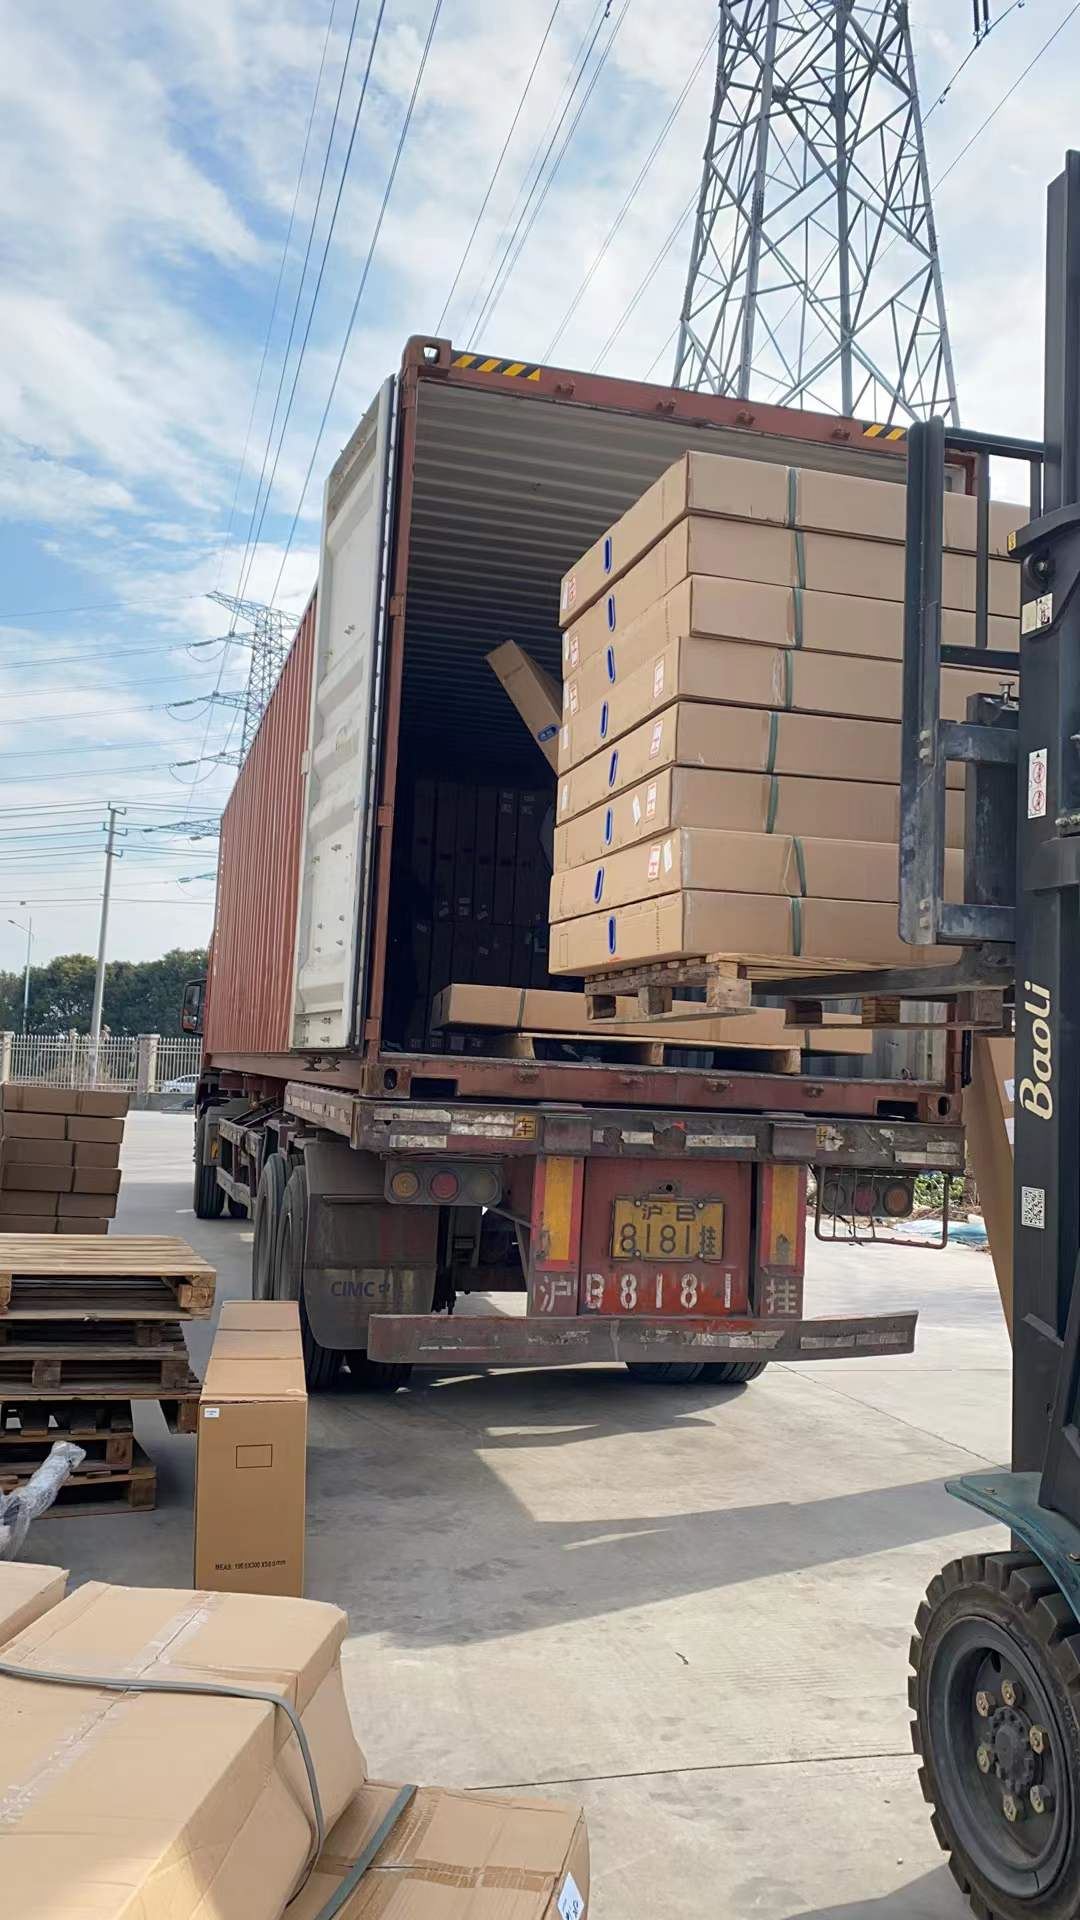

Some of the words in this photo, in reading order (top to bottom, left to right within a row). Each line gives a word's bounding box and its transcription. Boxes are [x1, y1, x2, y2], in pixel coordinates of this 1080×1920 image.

[1019, 980, 1053, 1120] Baoli
[620, 1221, 717, 1257] 8181挂
[331, 1280, 376, 1297] CIMC
